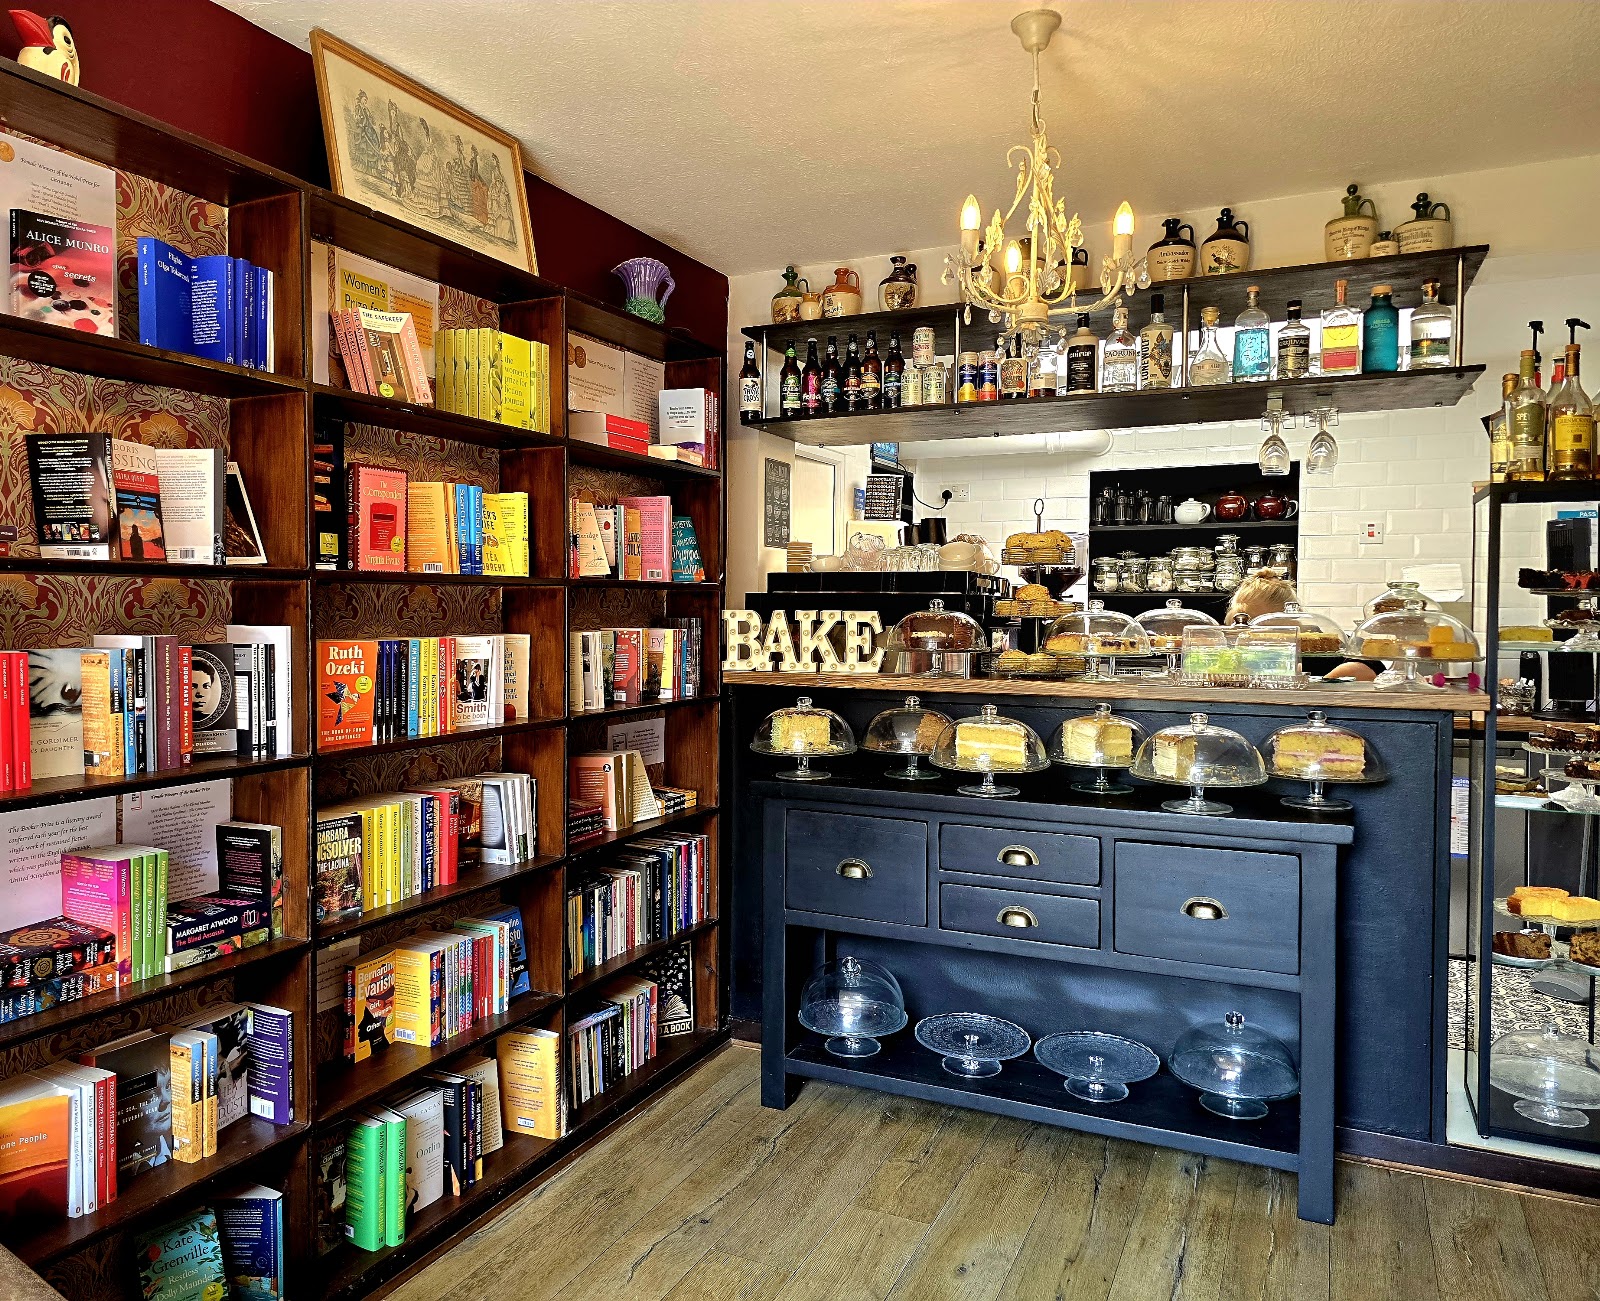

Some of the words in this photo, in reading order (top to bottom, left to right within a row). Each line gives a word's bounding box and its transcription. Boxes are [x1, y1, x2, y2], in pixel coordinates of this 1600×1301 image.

[26, 230, 62, 246] ALICE
[65, 239, 109, 254] MUNRO
[157, 260, 170, 272] Olga
[168, 252, 183, 266] Flights
[64, 271, 97, 282] secrets
[343, 271, 386, 299] Women's
[333, 315, 341, 328] THE
[343, 312, 351, 325] THE
[374, 314, 403, 322] SAFEKEEP
[336, 328, 348, 357] SAFEKEEP
[346, 326, 358, 355] SAFEKEEP
[504, 355, 513, 365] the
[504, 393, 525, 407] journal
[113, 443, 139, 454] DORIS
[114, 453, 156, 471] SSING
[379, 480, 388, 489] The
[365, 554, 386, 566] Virginia
[385, 555, 400, 566] Evans
[722, 610, 884, 673] BAKE
[329, 645, 363, 660] Ruth
[325, 660, 365, 676] Ozeki
[457, 704, 487, 713] Smith
[37, 736, 79, 746] GORDIMER
[40, 745, 75, 754] DAUGHTER
[8, 825, 19, 834] The
[20, 823, 39, 832] Booker
[40, 821, 54, 829] Prize
[65, 816, 85, 824] literary
[86, 811, 103, 821] award
[426, 801, 434, 829] ZADIE
[8, 833, 35, 845] conferred
[34, 831, 46, 839] each
[47, 830, 60, 838] year
[60, 827, 68, 837] for
[317, 827, 348, 844] BARBARA
[25, 842, 39, 850] work
[39, 841, 46, 849] of
[317, 837, 361, 861] GSOLVER
[426, 831, 434, 864] SMITH
[9, 856, 29, 864] written
[37, 851, 46, 859] the
[46, 847, 67, 858] English
[9, 866, 25, 874] which
[317, 862, 327, 873] THE
[328, 858, 349, 871] LACUNA
[9, 875, 29, 884] United
[30, 869, 55, 880] Kingdom
[176, 924, 209, 940] MARGARET
[210, 915, 239, 929] ATWOOD
[176, 940, 187, 948] The
[187, 935, 202, 943] Blind
[202, 929, 225, 939] Assassin
[65, 952, 74, 967] Hall
[13, 963, 24, 986] Hilary
[23, 958, 31, 984] Mantel
[19, 994, 28, 1017] Hilary
[366, 1022, 381, 1032] Other
[664, 1025, 669, 1033] A
[670, 1022, 691, 1032] BOOK
[219, 1095, 245, 1120] DUST
[0, 1141, 16, 1150] one
[19, 1132, 48, 1145] People
[161, 1234, 193, 1255] Kate
[151, 1244, 210, 1275] Grenville
[168, 1266, 199, 1285] Restless
[156, 1286, 179, 1301] Dolly
[179, 1272, 215, 1295] Maunder
